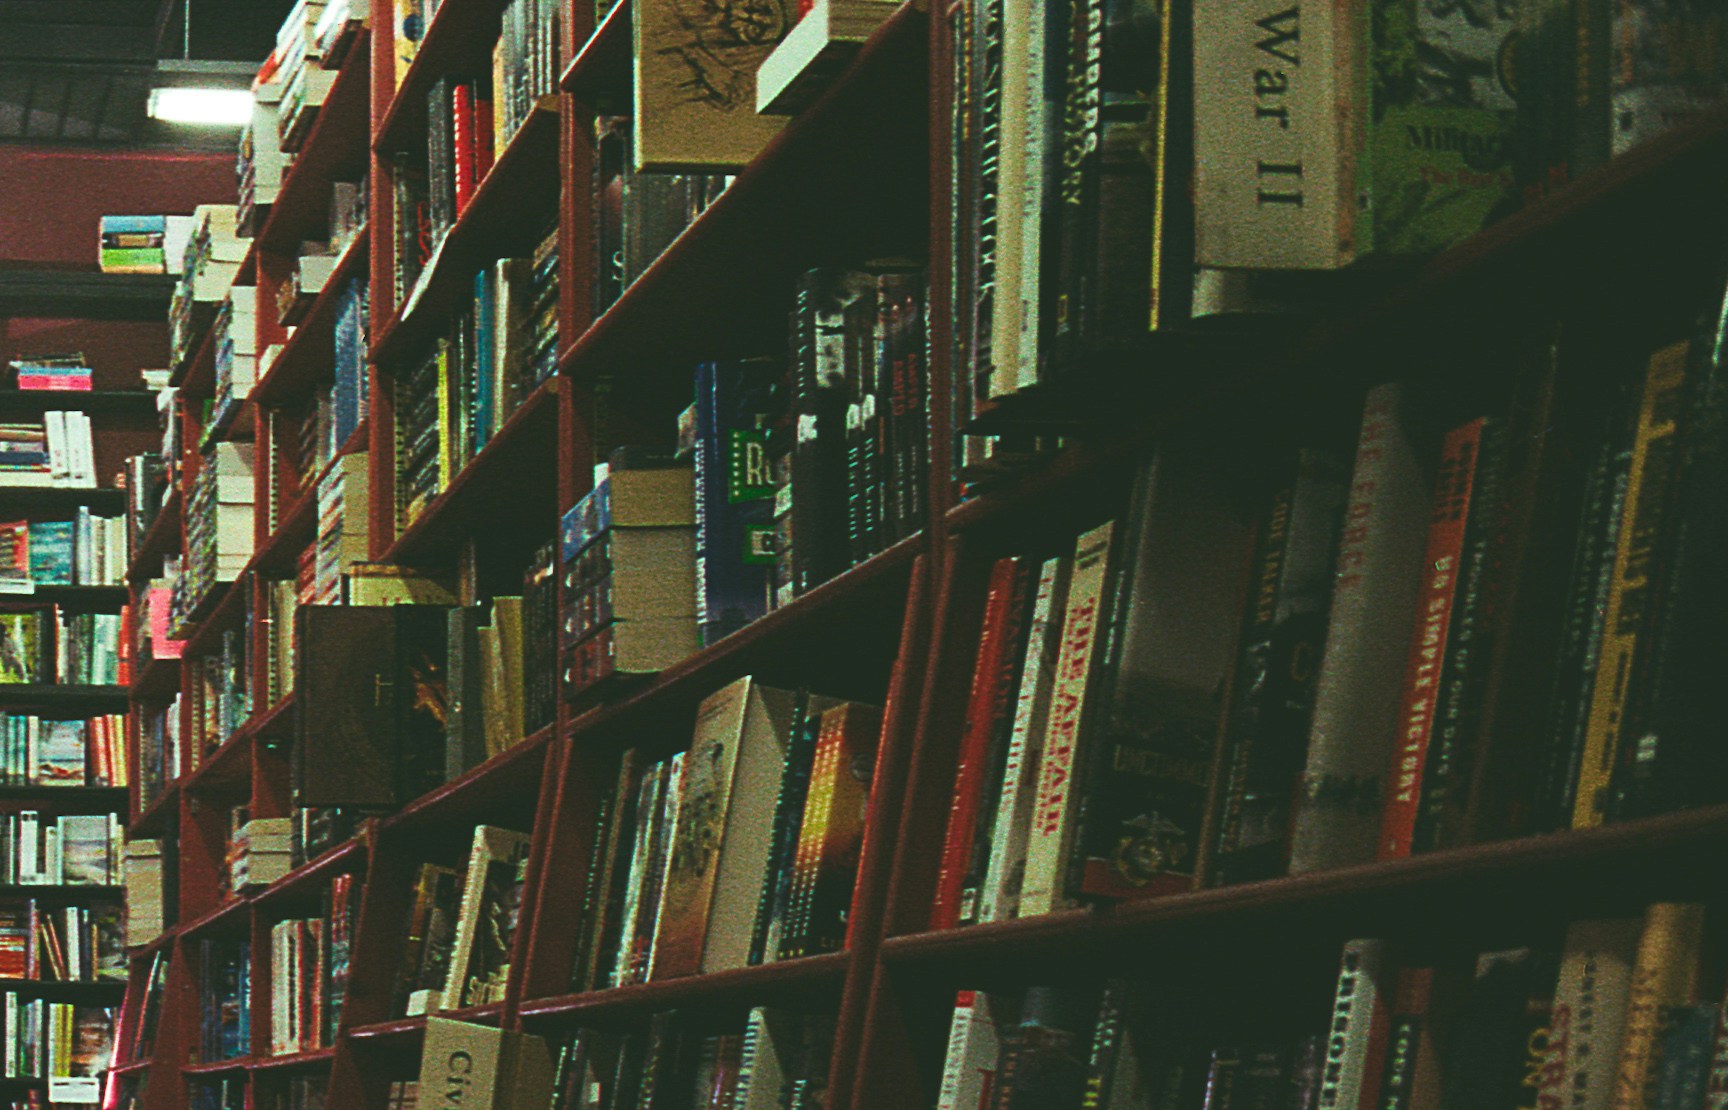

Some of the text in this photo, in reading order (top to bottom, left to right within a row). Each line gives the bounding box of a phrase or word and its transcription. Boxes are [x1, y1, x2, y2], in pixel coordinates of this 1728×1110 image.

[1253, 7, 1303, 208] War II
[1416, 595, 1447, 691] SIMPLE
[1043, 692, 1081, 837] AFFAIR
[1396, 698, 1426, 802] VICTORY
[1388, 1023, 1412, 1081] CODE
[1521, 1027, 1549, 1088] ON
